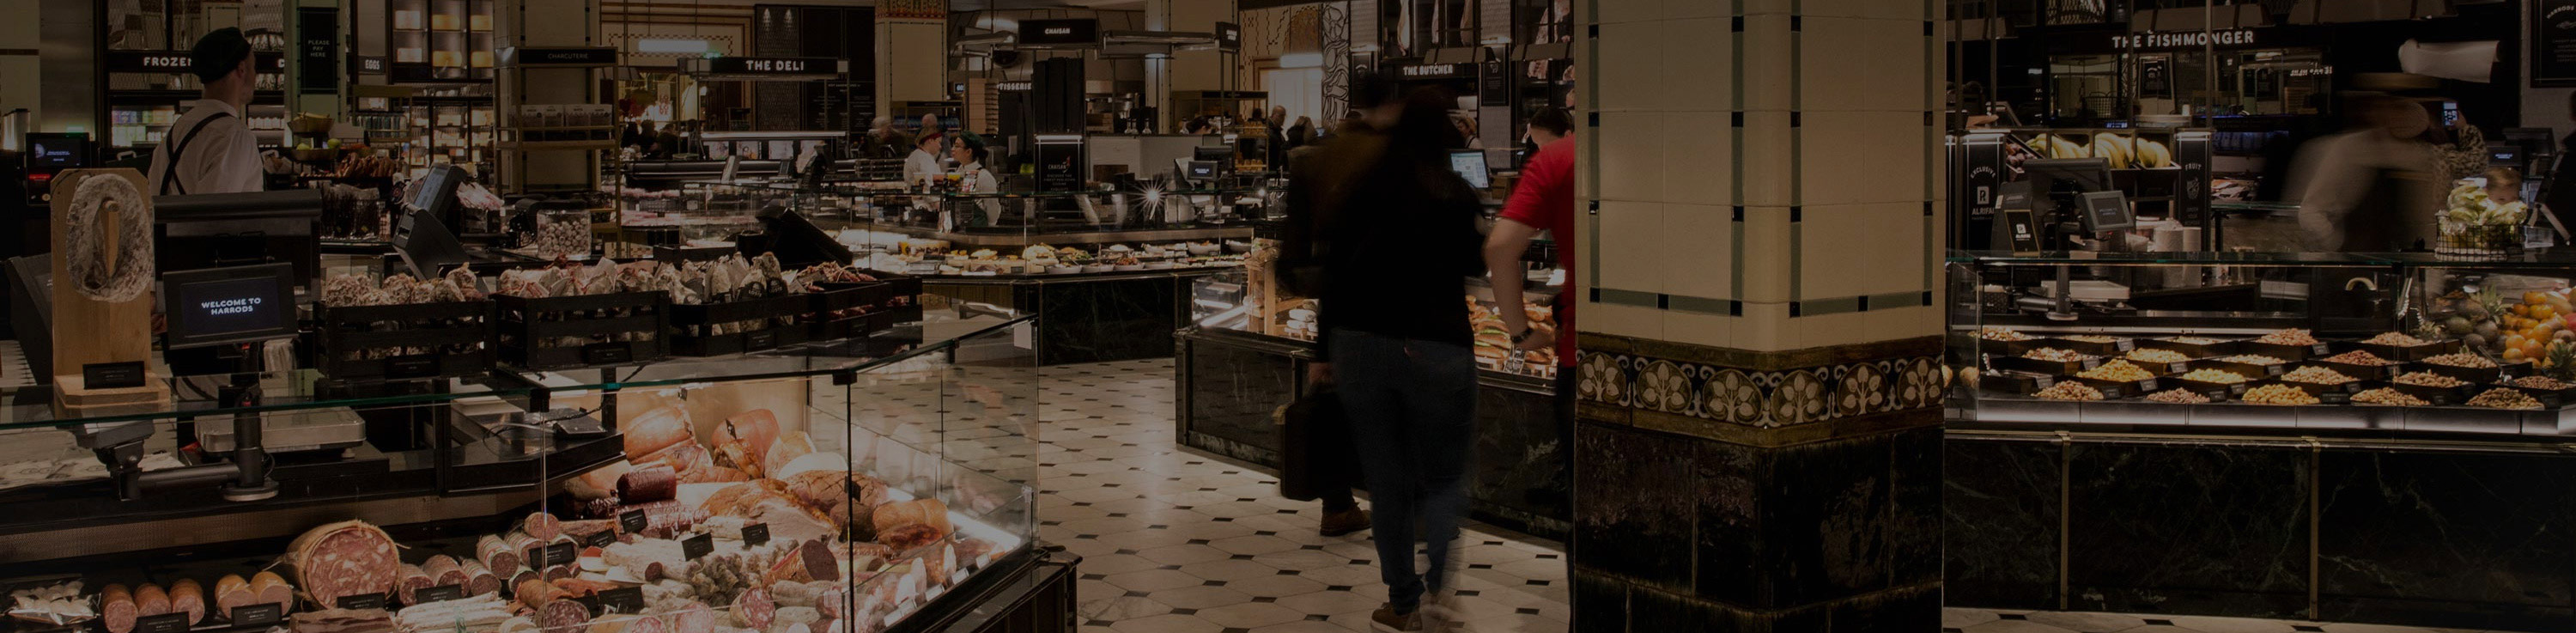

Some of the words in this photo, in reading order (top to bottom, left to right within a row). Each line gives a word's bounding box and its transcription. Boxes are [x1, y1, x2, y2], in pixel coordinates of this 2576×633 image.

[2111, 34, 2142, 49] THE
[2147, 30, 2254, 47] FISHMONGER
[745, 60, 771, 71] THE
[775, 60, 805, 71] DELI
[1402, 66, 1418, 76] THE
[1419, 64, 1454, 76] BUTCHER
[2184, 162, 2202, 171] FRUIT
[1970, 166, 1996, 180] EXCLUSIVE
[201, 298, 247, 308] WELCOME
[210, 305, 253, 315] HARRODS
